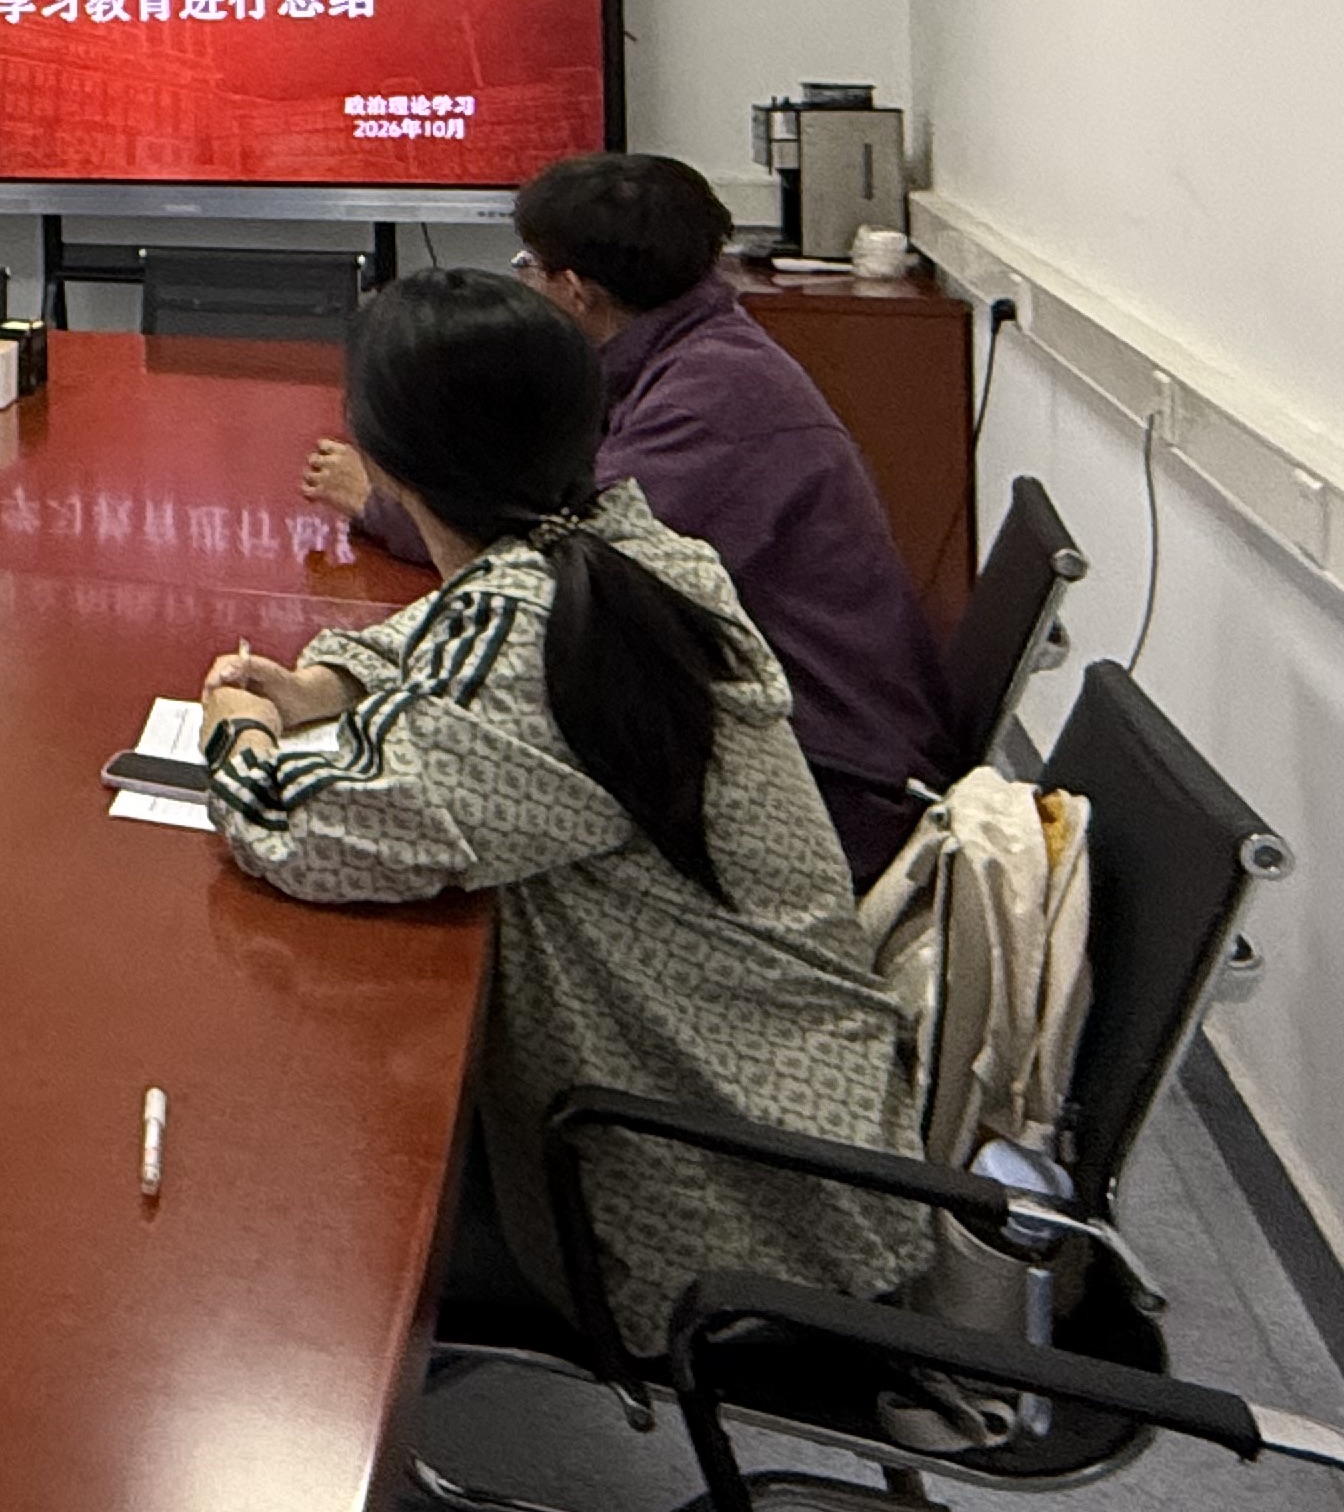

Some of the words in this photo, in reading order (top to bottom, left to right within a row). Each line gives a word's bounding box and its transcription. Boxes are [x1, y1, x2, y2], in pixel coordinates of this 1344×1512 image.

[344, 94, 475, 116] 政治理论学习
[353, 118, 465, 139] 2026年10月
